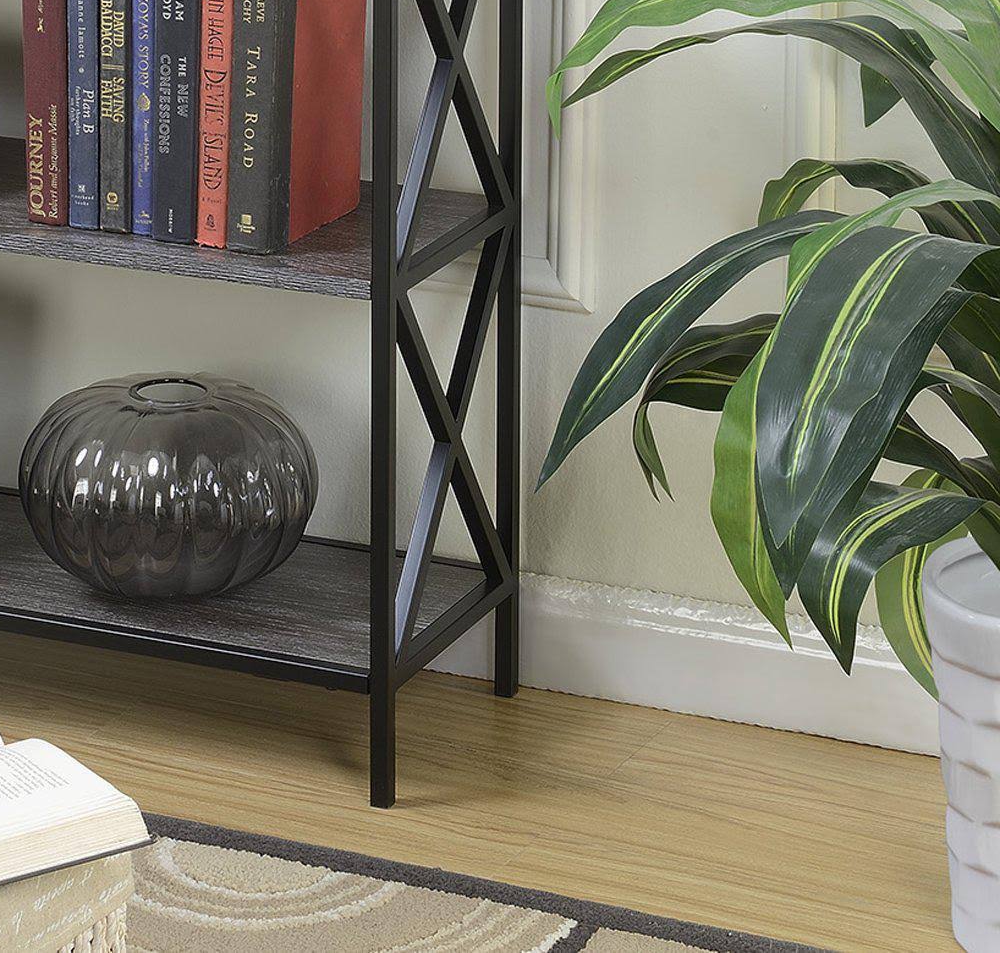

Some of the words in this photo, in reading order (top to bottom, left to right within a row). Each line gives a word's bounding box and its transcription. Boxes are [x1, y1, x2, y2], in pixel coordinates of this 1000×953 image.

[101, 0, 113, 57] BALDACCI
[113, 11, 125, 48] DAVID
[207, 17, 224, 61] HAGEE
[138, 45, 149, 88] STORY
[178, 56, 187, 77] THE
[245, 45, 261, 98] TARA
[82, 88, 95, 118] Plan
[100, 79, 113, 119] FAITH
[113, 76, 125, 123] SAVING
[158, 54, 172, 154] CONFESSIONS
[177, 83, 189, 118] NEW
[82, 123, 95, 135] B
[243, 111, 259, 168] ROAD
[28, 113, 46, 218] JOURNEY
[202, 132, 226, 190] ISLAND
